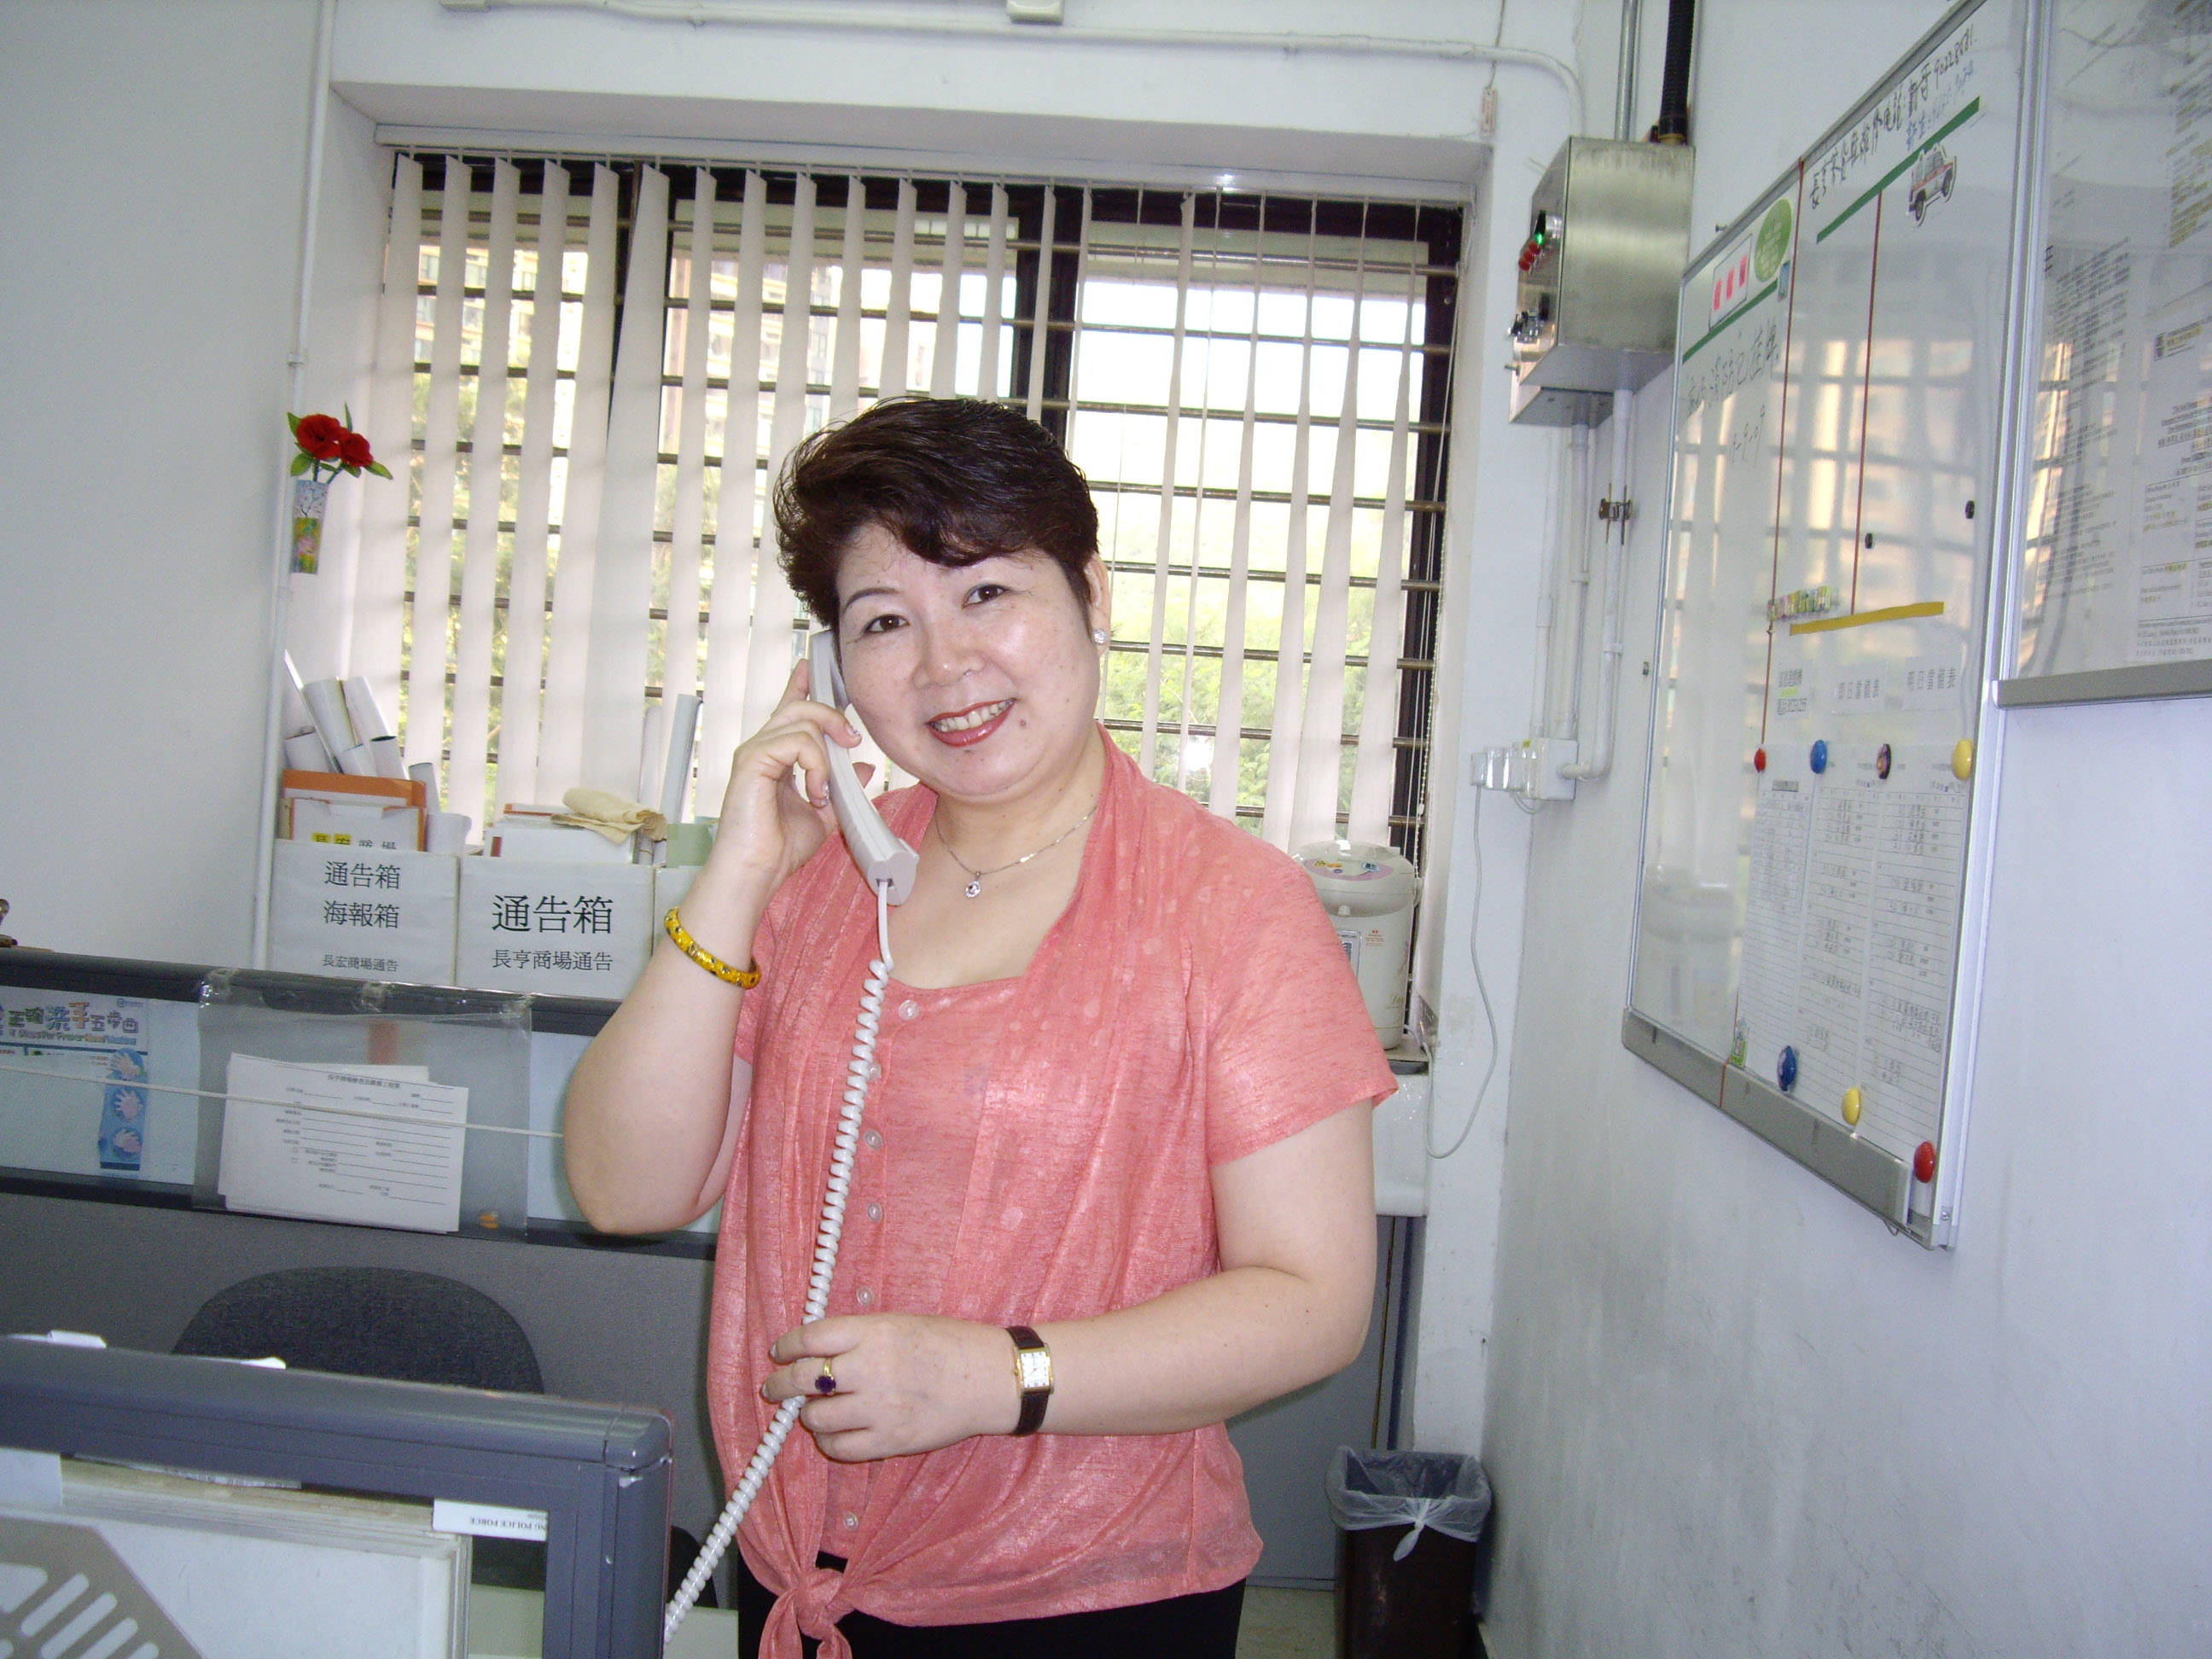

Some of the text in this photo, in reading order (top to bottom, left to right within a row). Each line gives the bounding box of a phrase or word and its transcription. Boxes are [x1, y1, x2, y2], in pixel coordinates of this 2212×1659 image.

[324, 860, 401, 889] 通告箱
[323, 900, 399, 928] 海報箱
[492, 894, 614, 934] 通告箱
[322, 954, 399, 972] 長宏商場通告
[492, 949, 613, 971] 長亨商場通告
[469, 1517, 498, 1528] FORCE
[500, 1519, 532, 1529] POLICE
